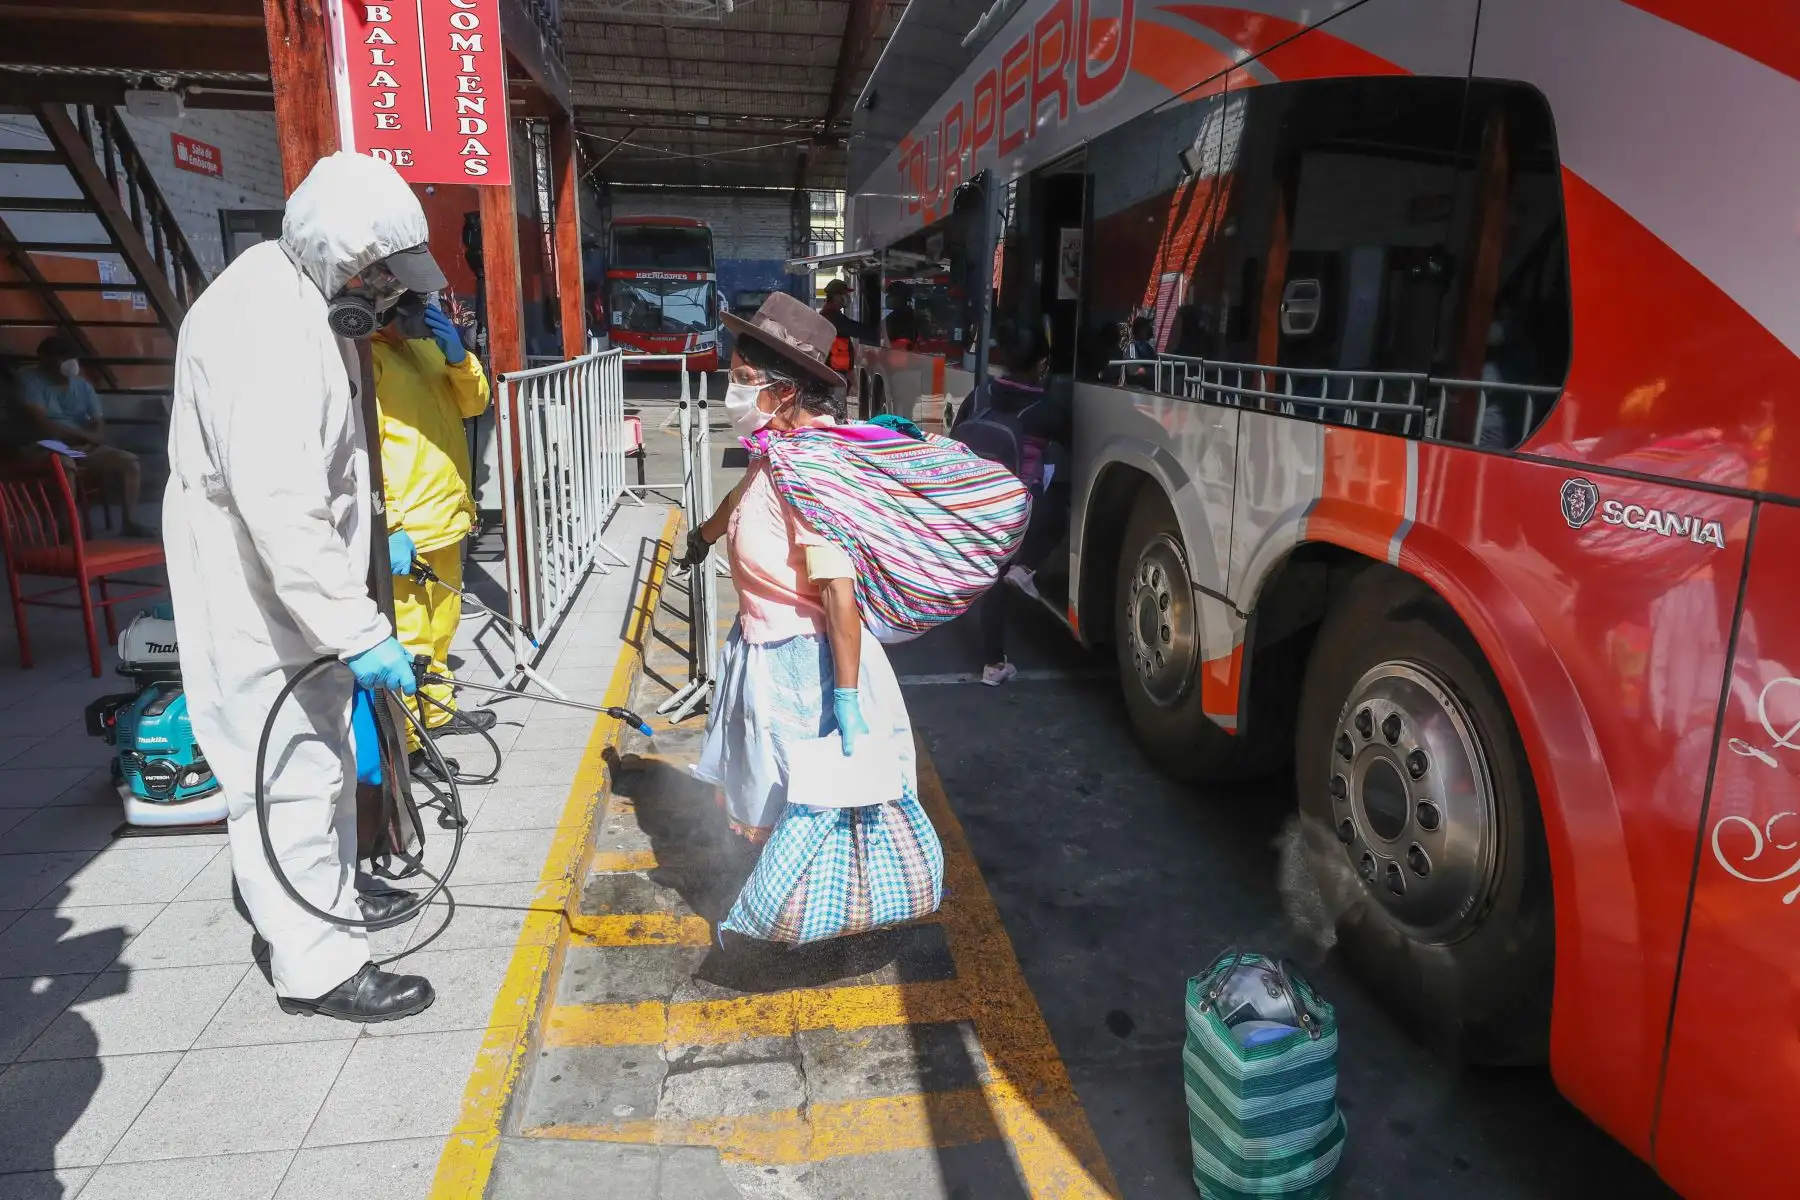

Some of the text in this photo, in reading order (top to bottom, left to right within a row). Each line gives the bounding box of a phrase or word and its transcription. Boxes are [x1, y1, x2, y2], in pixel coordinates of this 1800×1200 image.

[364, 0, 402, 130] BALAJE
[189, 154, 217, 172] Embarque
[370, 148, 414, 166] DE
[1602, 500, 1724, 548] SCANIA
